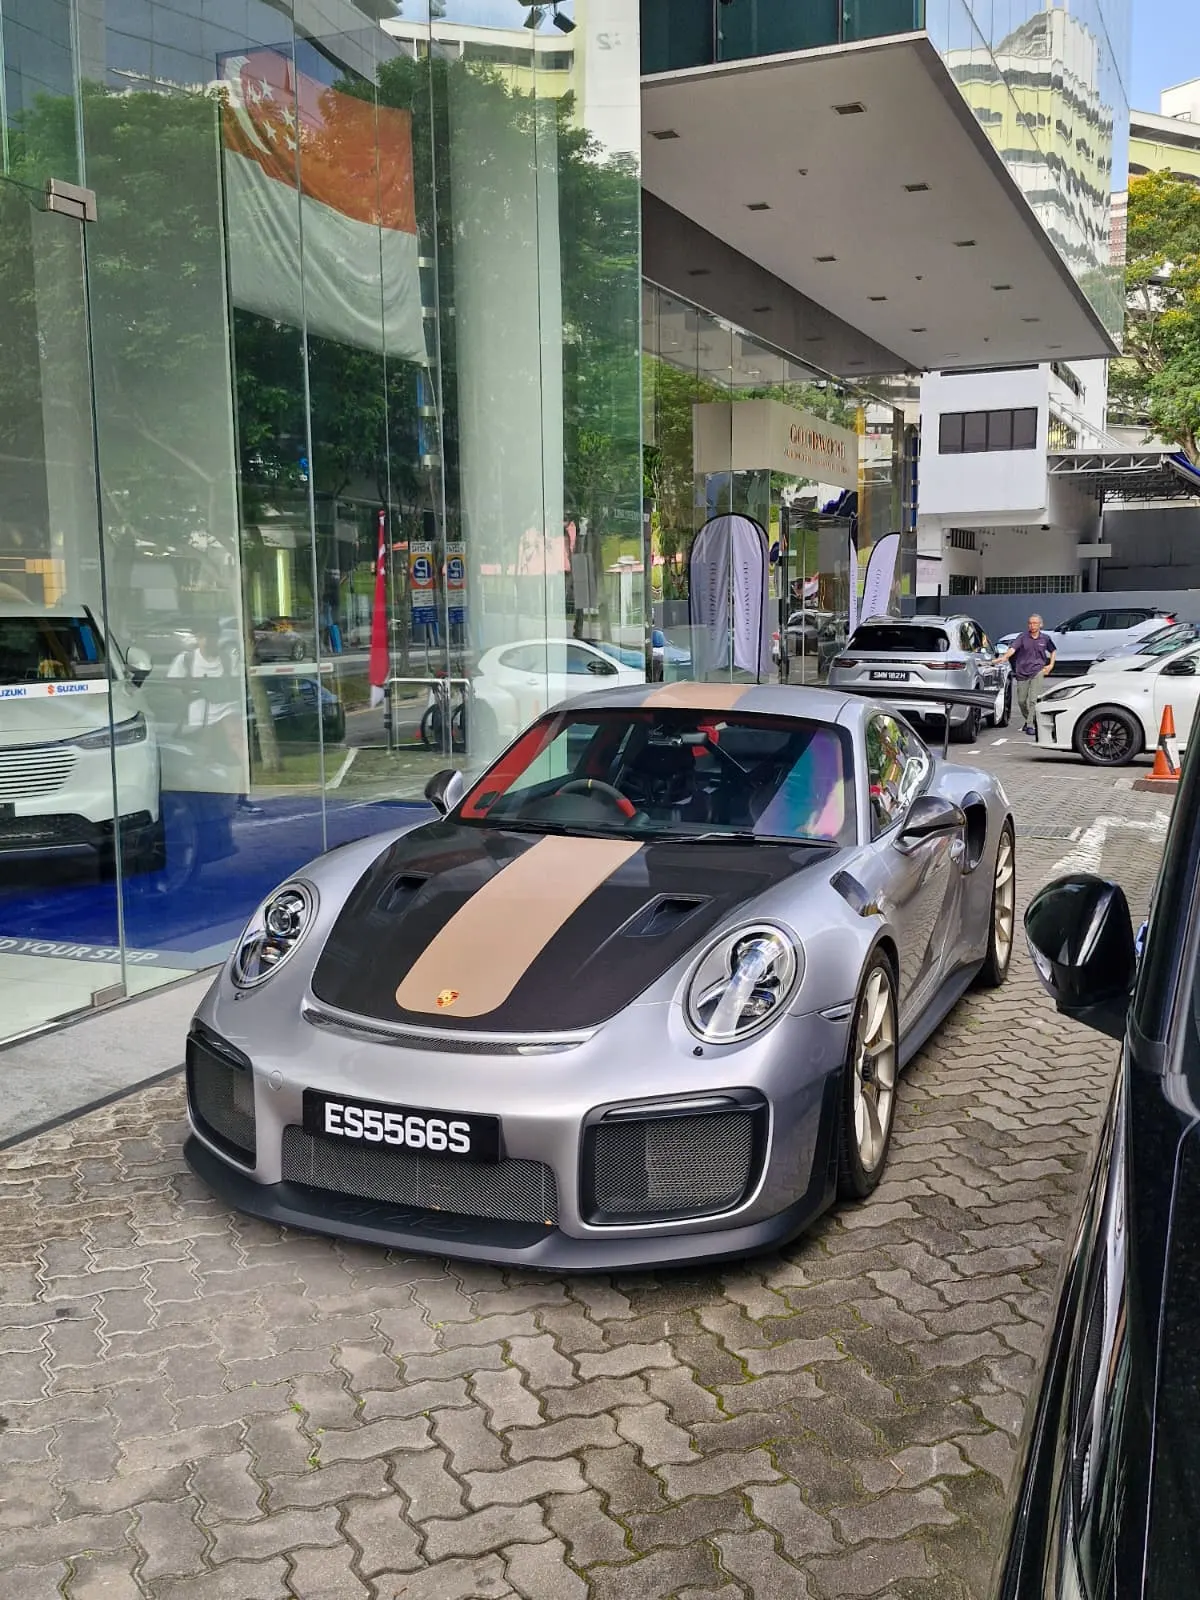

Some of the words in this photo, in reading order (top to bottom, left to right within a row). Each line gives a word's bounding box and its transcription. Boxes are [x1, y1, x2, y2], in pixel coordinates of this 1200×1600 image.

[0, 688, 26, 697] UZUKI
[57, 684, 88, 693] SUZUKI
[17, 942, 91, 958] YOUR
[88, 948, 160, 963] STEP
[324, 1101, 471, 1153] ES5566S
